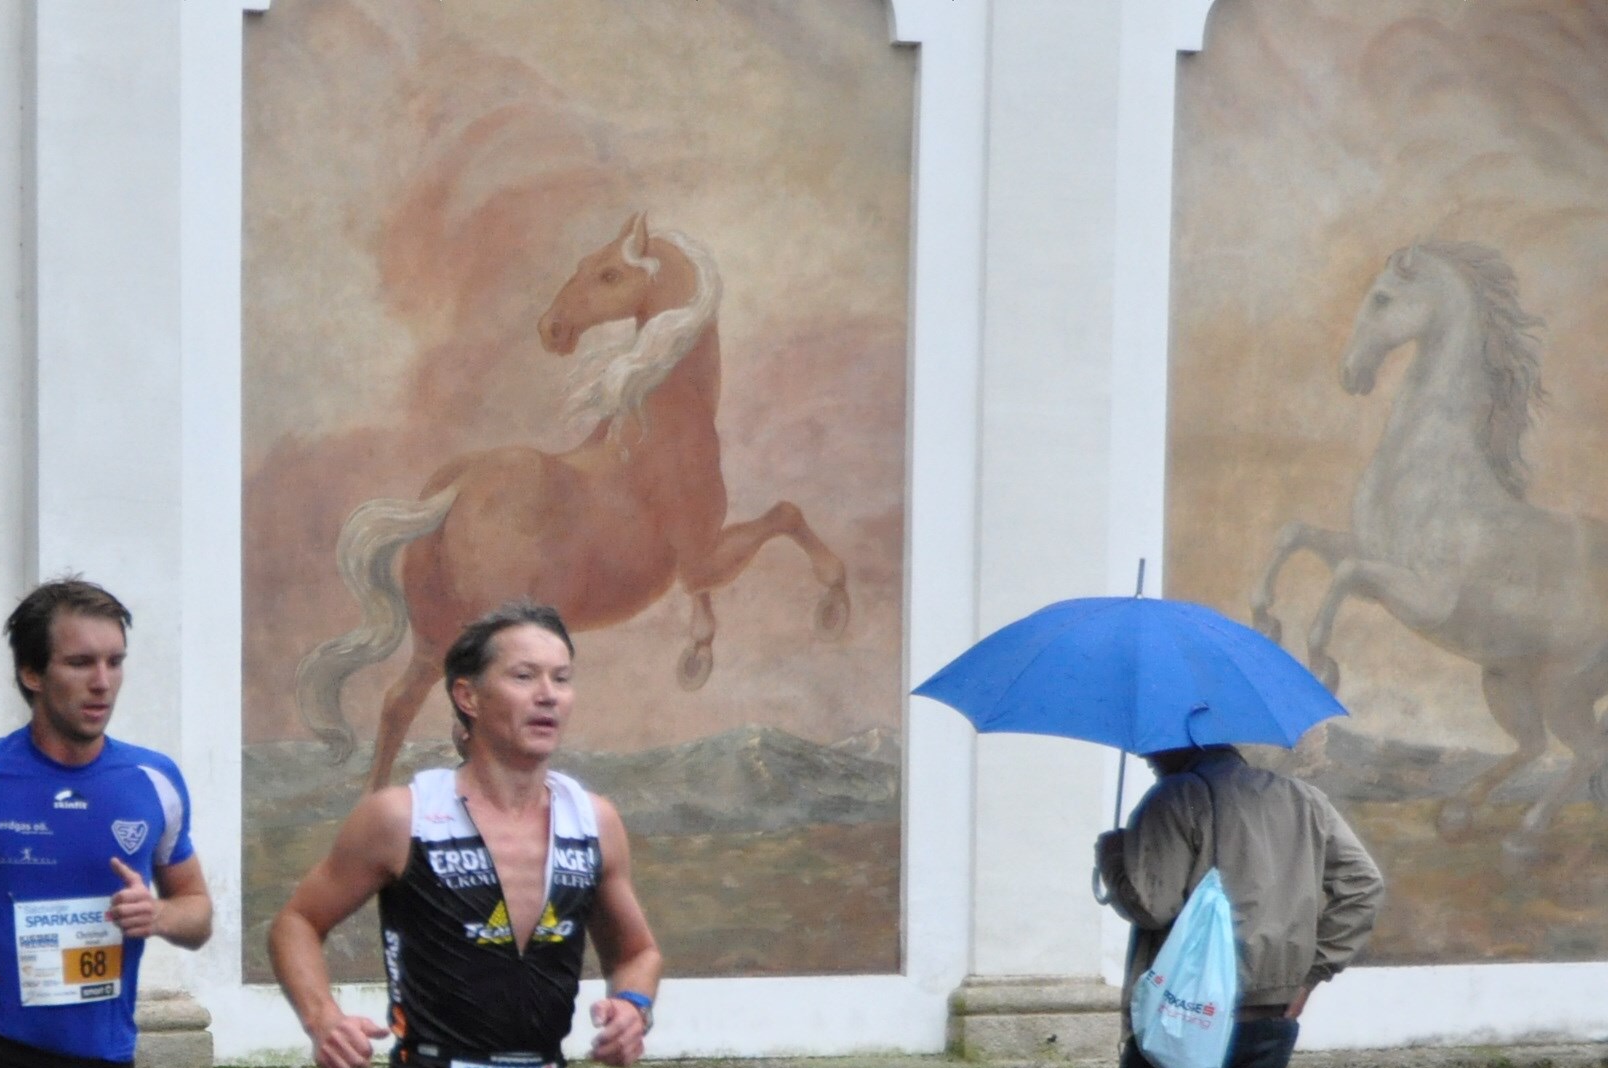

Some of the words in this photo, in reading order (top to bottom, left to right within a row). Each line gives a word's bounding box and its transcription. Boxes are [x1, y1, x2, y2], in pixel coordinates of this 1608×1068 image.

[54, 801, 88, 810] skinfit
[25, 911, 103, 928] SPARKASSE
[80, 950, 106, 978] 68
